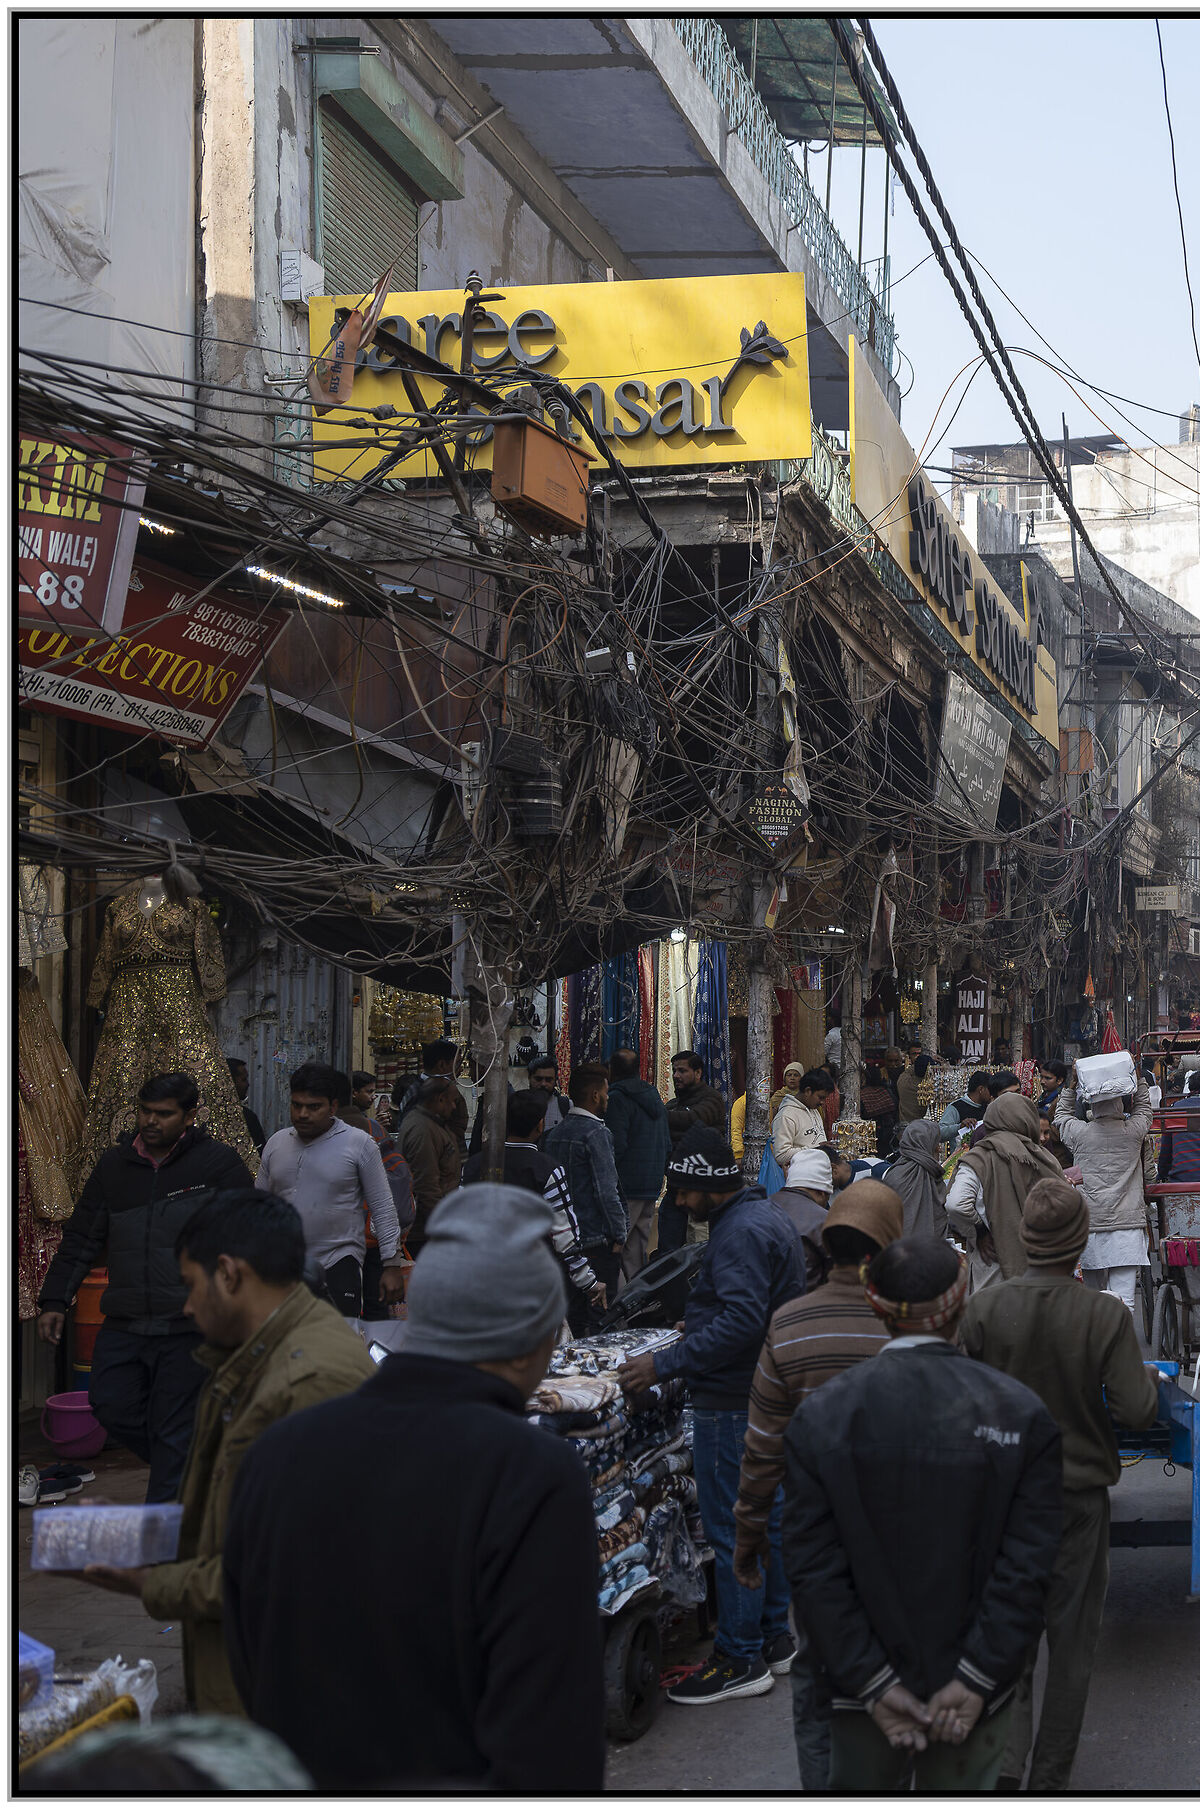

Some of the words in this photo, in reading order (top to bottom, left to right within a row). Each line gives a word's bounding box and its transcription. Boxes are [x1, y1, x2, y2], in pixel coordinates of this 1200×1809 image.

[49, 529, 99, 577] WALE)
[909, 475, 974, 636] Saree
[182, 621, 257, 658] 7838318407
[974, 577, 1038, 716] Sansar
[19, 629, 238, 706] OLLECTIONS
[971, 717, 987, 746] HAJI
[986, 728, 996, 752] ALI
[749, 807, 802, 817] FASHION
[755, 798, 796, 808] NAGINA
[758, 815, 792, 823] GLOBAL
[958, 990, 985, 1008] HAJI
[957, 1014, 984, 1033] ALI
